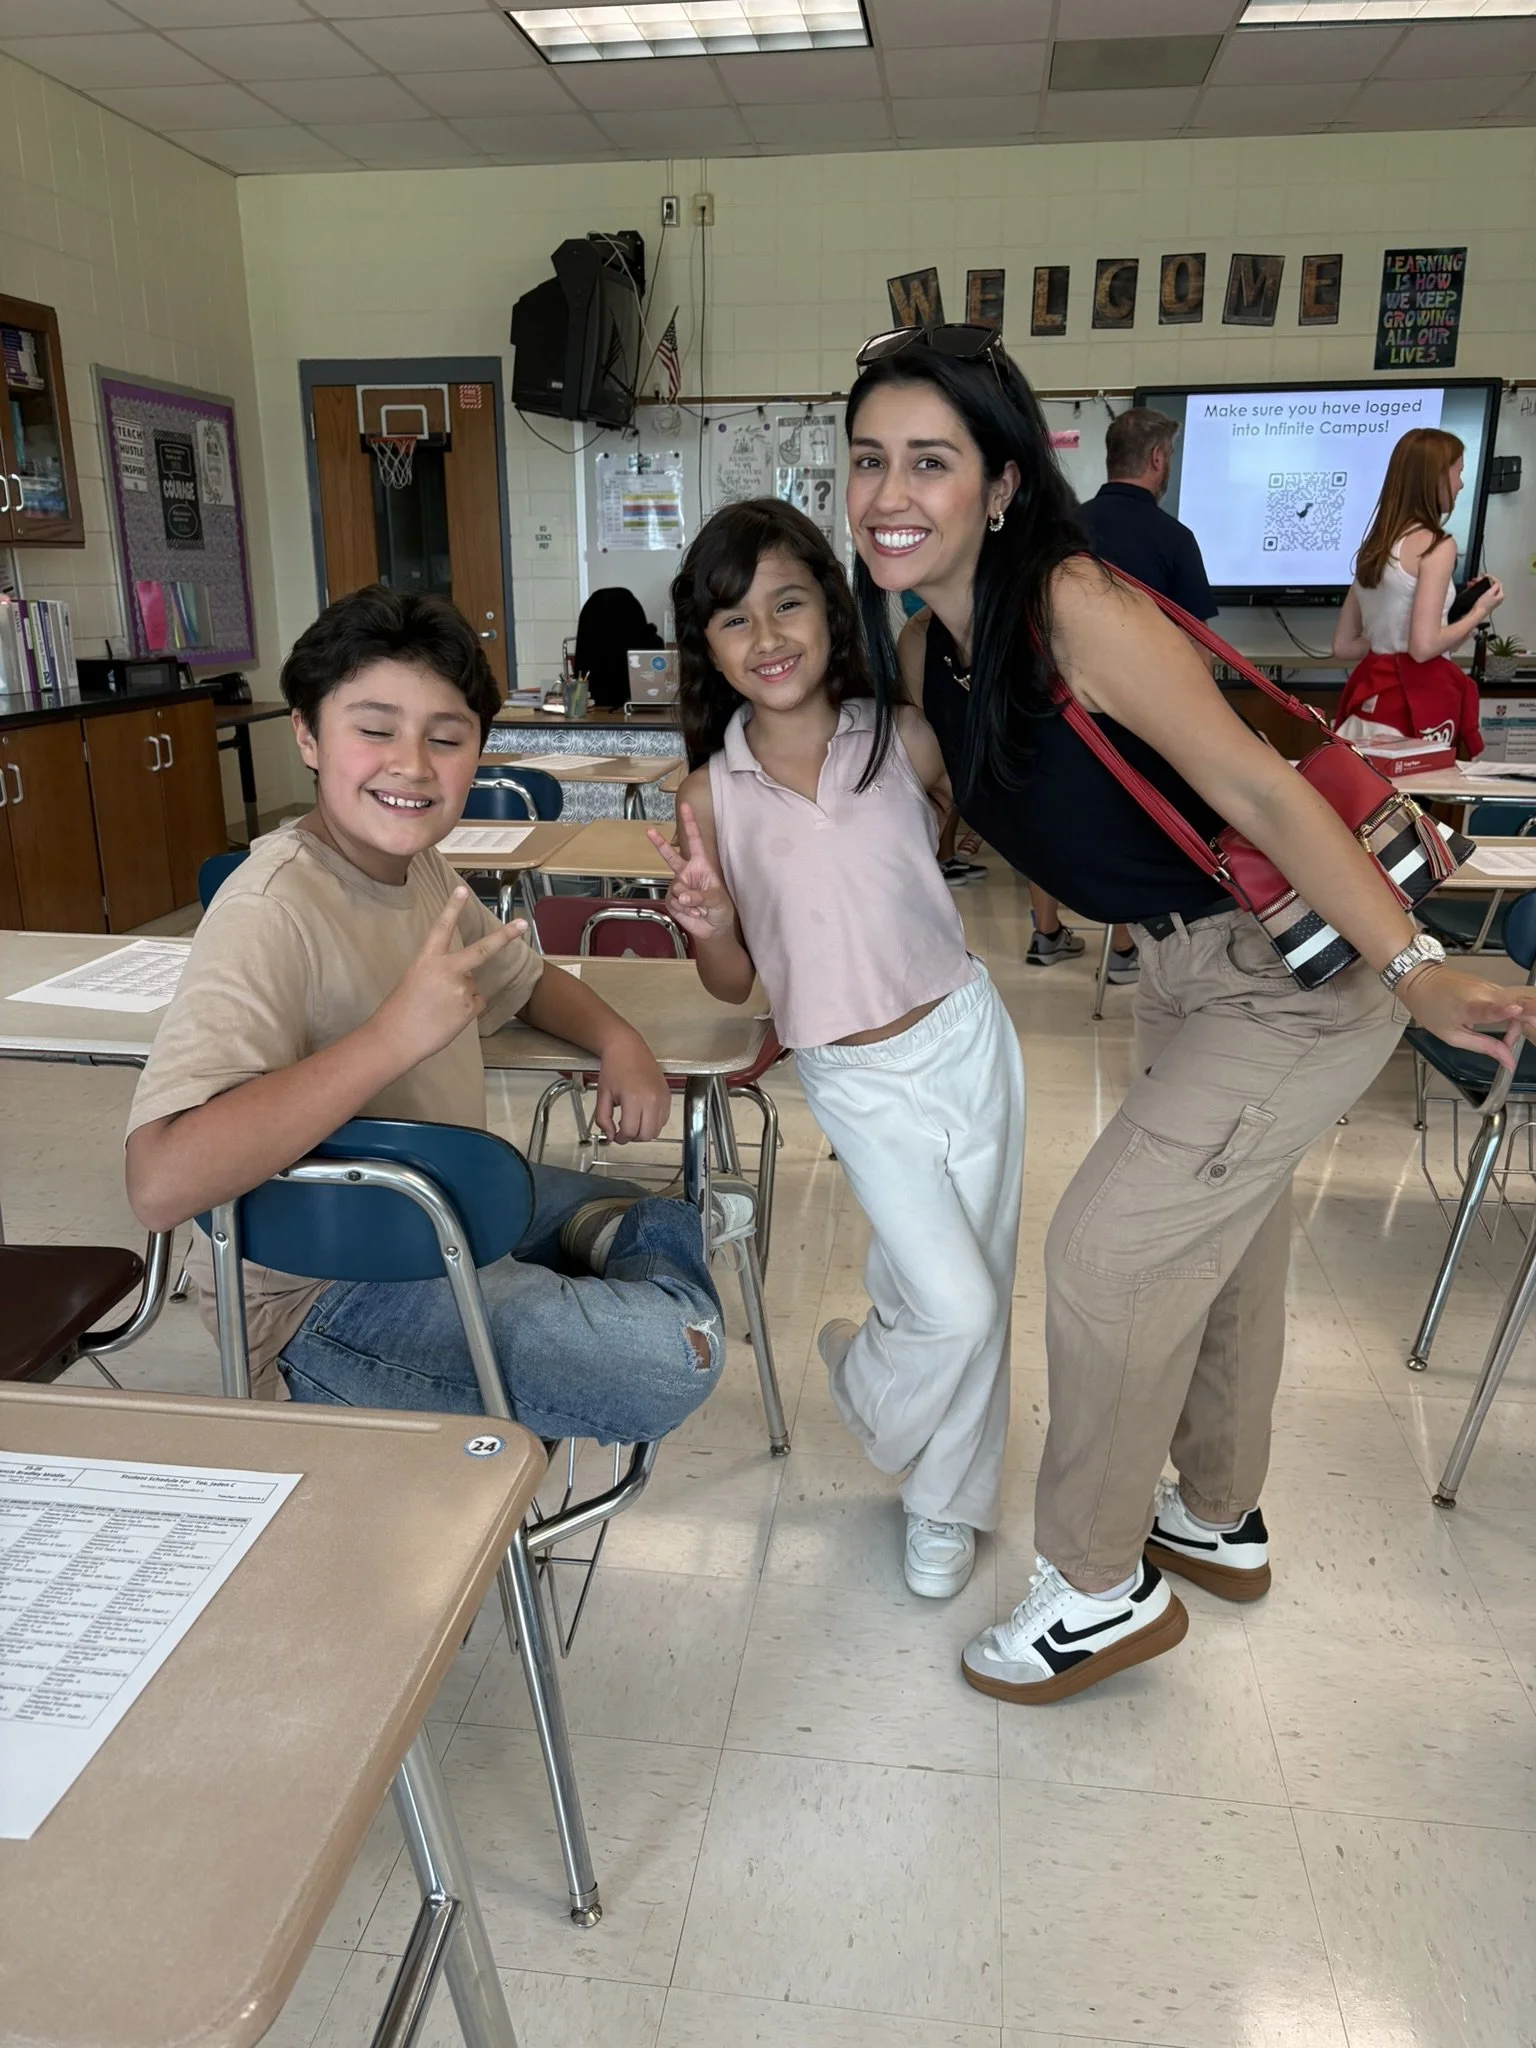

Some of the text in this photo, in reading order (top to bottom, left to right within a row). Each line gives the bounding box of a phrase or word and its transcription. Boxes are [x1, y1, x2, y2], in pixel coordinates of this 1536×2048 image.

[1386, 254, 1464, 273] LEARNING
[1395, 273, 1452, 291] IS HOW
[892, 256, 1337, 328] WELCOME
[1386, 291, 1457, 309] WE KEEP
[1383, 310, 1457, 329] GROWING
[1384, 328, 1450, 346] ALL OUR
[1390, 346, 1440, 364] LIVES.
[1204, 399, 1422, 418] Make sure you have logged
[117, 426, 142, 440] TEACH
[1232, 420, 1390, 437] into Infinite Campus!
[120, 444, 144, 457] HUSTLE
[122, 464, 146, 475] INSPIRE
[163, 480, 196, 500] COURAGE
[471, 1440, 497, 1452] 24
[149, 1475, 179, 1483] Schedule
